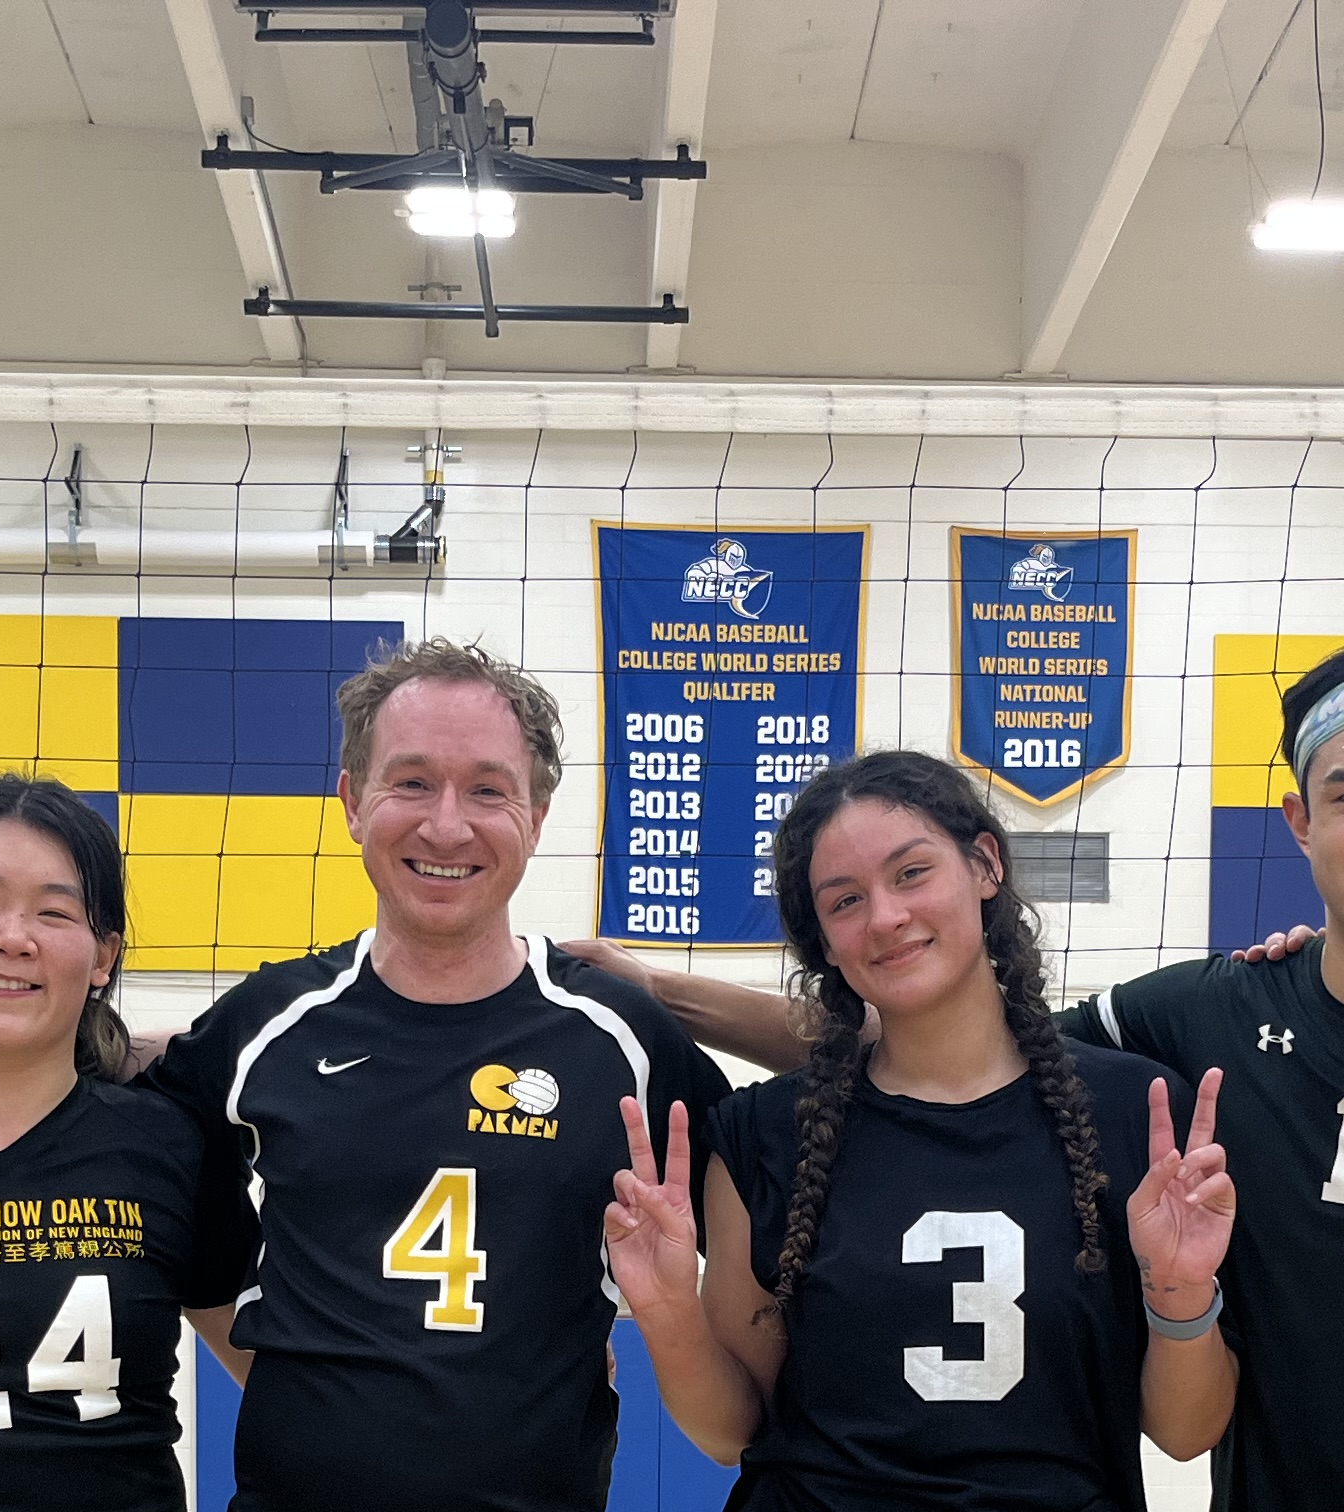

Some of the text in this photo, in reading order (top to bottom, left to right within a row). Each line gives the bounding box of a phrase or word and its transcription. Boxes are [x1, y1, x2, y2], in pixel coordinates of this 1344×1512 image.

[687, 576, 750, 598] NECC
[1012, 571, 1058, 587] NECC
[973, 603, 1116, 623] NJCAA BASEBALL
[651, 622, 809, 643] NJCAA BASEBALL
[1007, 631, 1080, 649] COLLEGE
[618, 650, 841, 673] COLLEGE WORLD SERIES
[979, 657, 1108, 676] WORLD SERIES
[683, 681, 776, 703] QUALIFER
[1001, 684, 1087, 702] NATIONAL
[626, 713, 704, 743] 2006
[757, 715, 830, 745] 2018
[994, 711, 1093, 730] RUNNER-UP
[629, 752, 701, 781] 2012
[1003, 738, 1081, 768] 2016
[629, 789, 701, 820] 2013
[755, 793, 798, 821] 20
[629, 827, 701, 858] 2014
[628, 866, 700, 897] 2015
[627, 904, 700, 935] 2016
[467, 1108, 559, 1140] PAKMEN
[52, 1197, 99, 1225] OAK
[104, 1199, 143, 1227] TIN
[26, 1228, 44, 1240] OF
[49, 1226, 79, 1239] NEW
[84, 1226, 143, 1242] ENGLAND
[383, 1168, 487, 1333] 4
[902, 1211, 1024, 1401] 3
